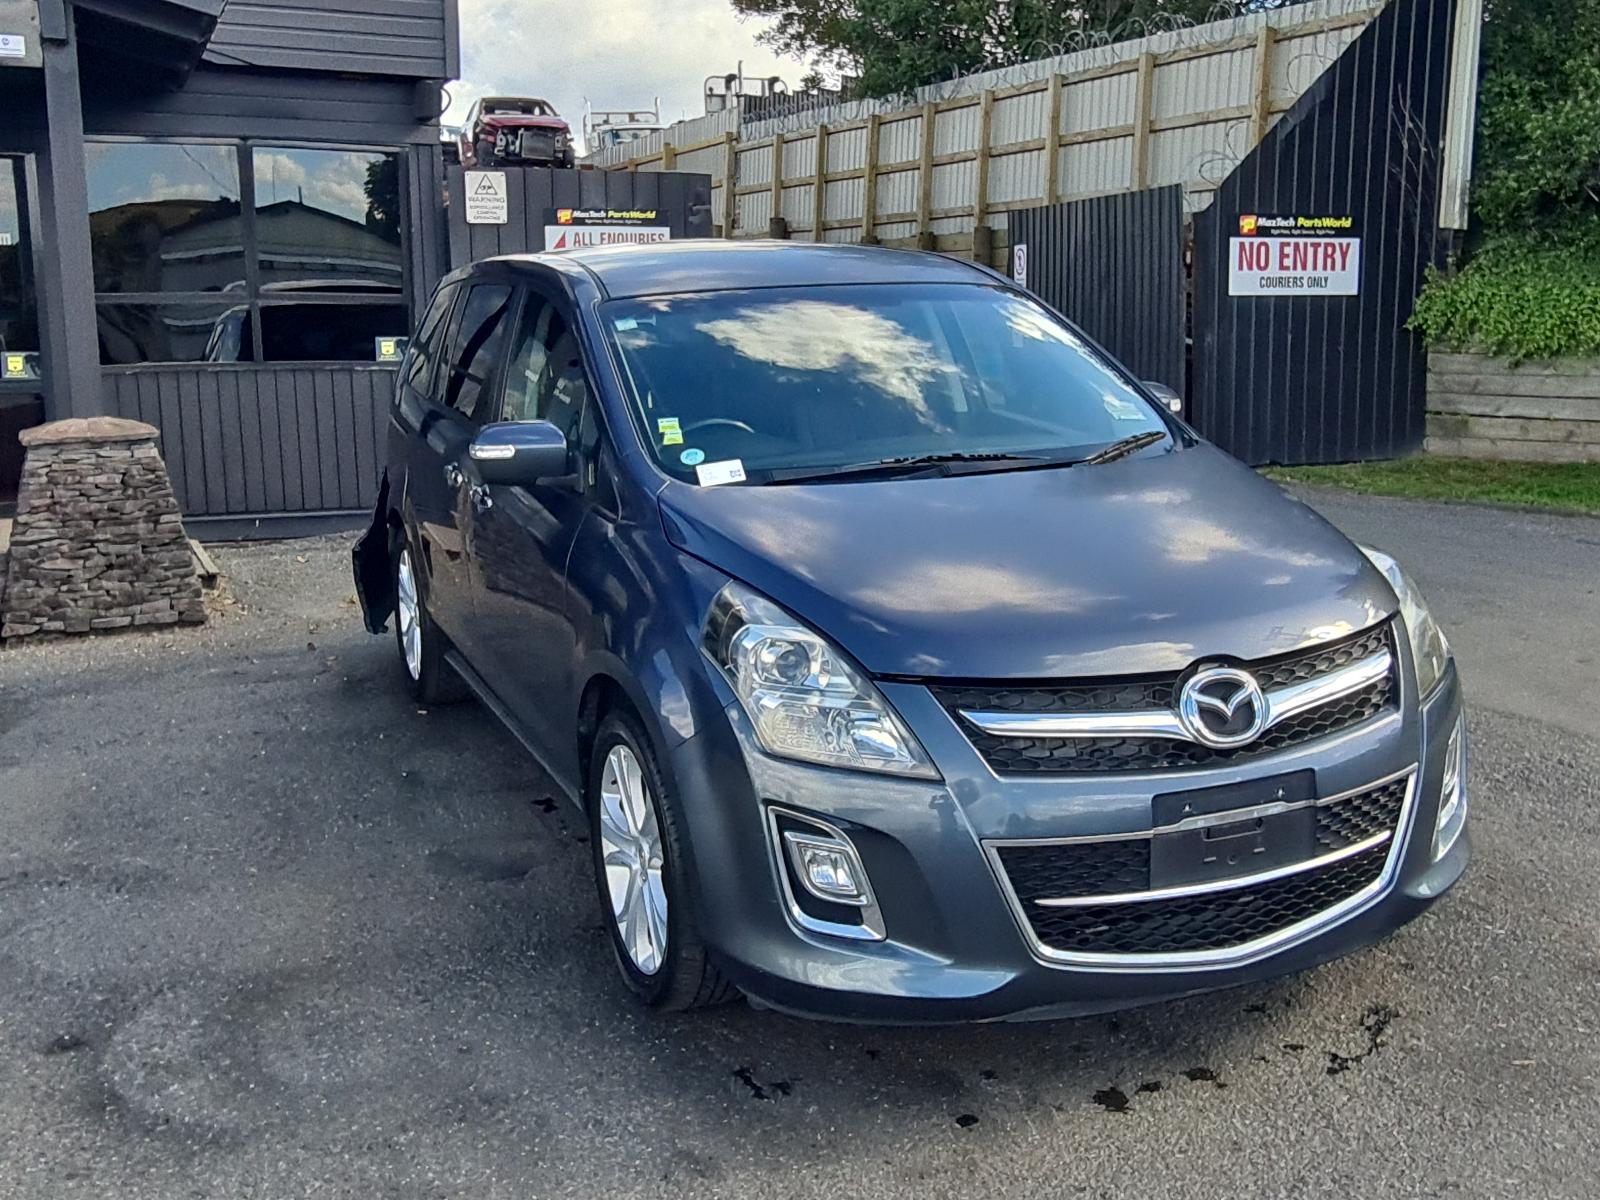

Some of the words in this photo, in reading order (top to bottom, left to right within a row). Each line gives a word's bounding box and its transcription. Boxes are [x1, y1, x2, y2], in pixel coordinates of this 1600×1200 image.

[607, 210, 657, 219] PartsWorld
[1257, 216, 1296, 228] MazTech
[1297, 216, 1352, 229] PartsWorld
[573, 231, 594, 247] ALL
[1238, 241, 1270, 272] NO
[1279, 241, 1351, 272] ENTRY
[1259, 276, 1304, 289] COURIERS
[1307, 276, 1329, 289] ONLY
